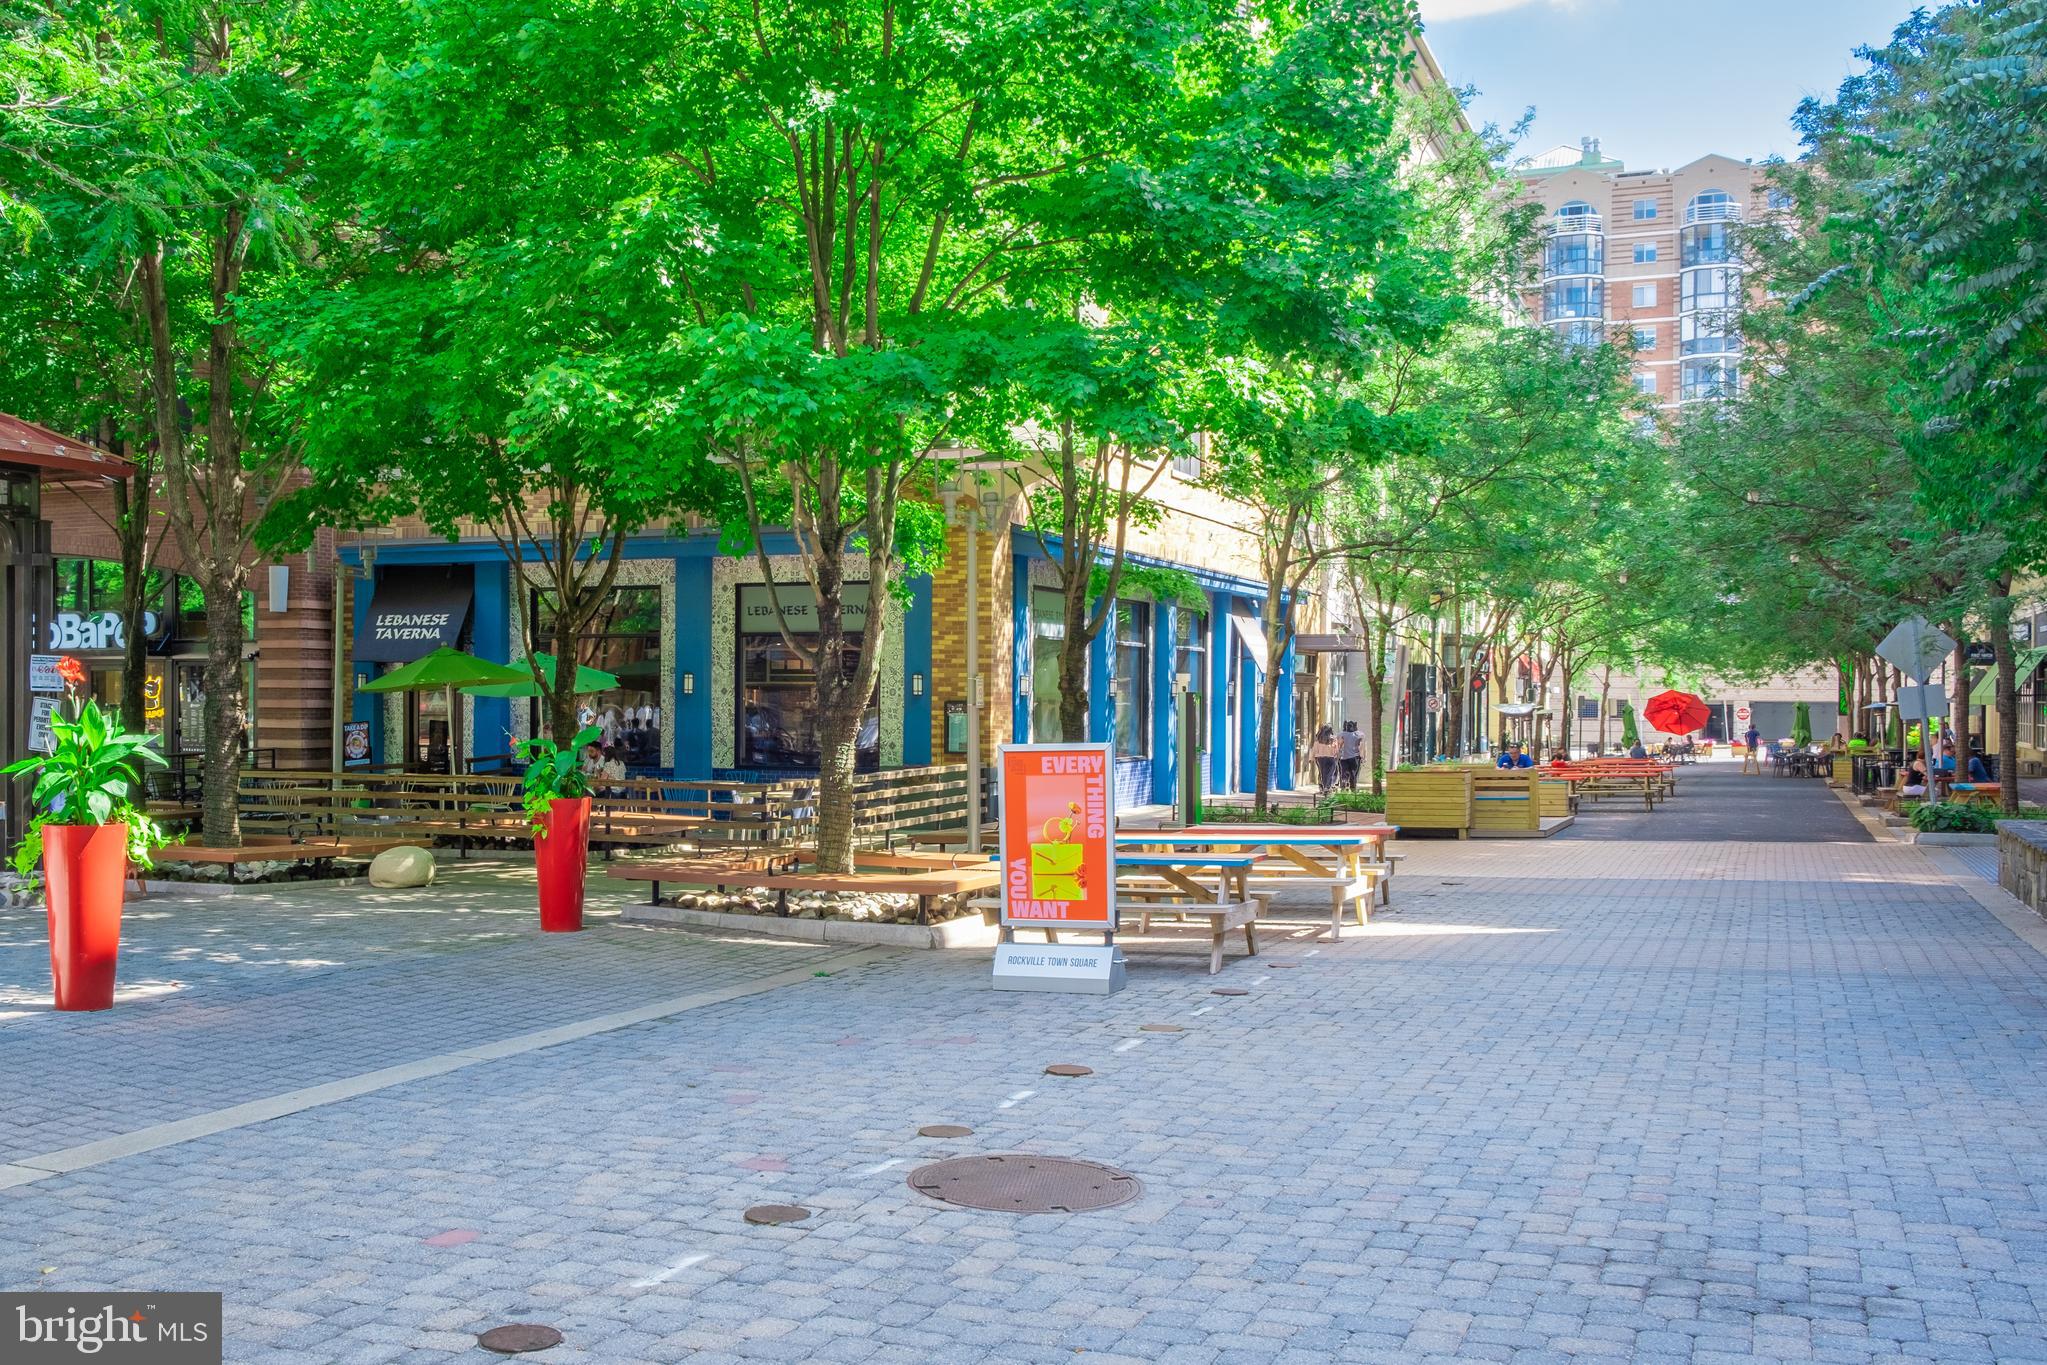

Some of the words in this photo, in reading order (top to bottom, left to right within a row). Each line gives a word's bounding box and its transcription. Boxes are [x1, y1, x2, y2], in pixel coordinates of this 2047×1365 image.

[814, 604, 868, 615] TERN
[375, 613, 450, 626] LEBANESE
[32, 612, 156, 650] oBaPo
[375, 627, 441, 640] TAVERNA
[1041, 756, 1103, 774] EVERY
[1086, 774, 1104, 839] THING
[1010, 858, 1027, 899] YOU
[1012, 901, 1070, 919] WANT
[1008, 955, 1045, 966] ROCKVILLE
[1047, 957, 1069, 967] TOWN
[1070, 958, 1099, 968] SQUARE
